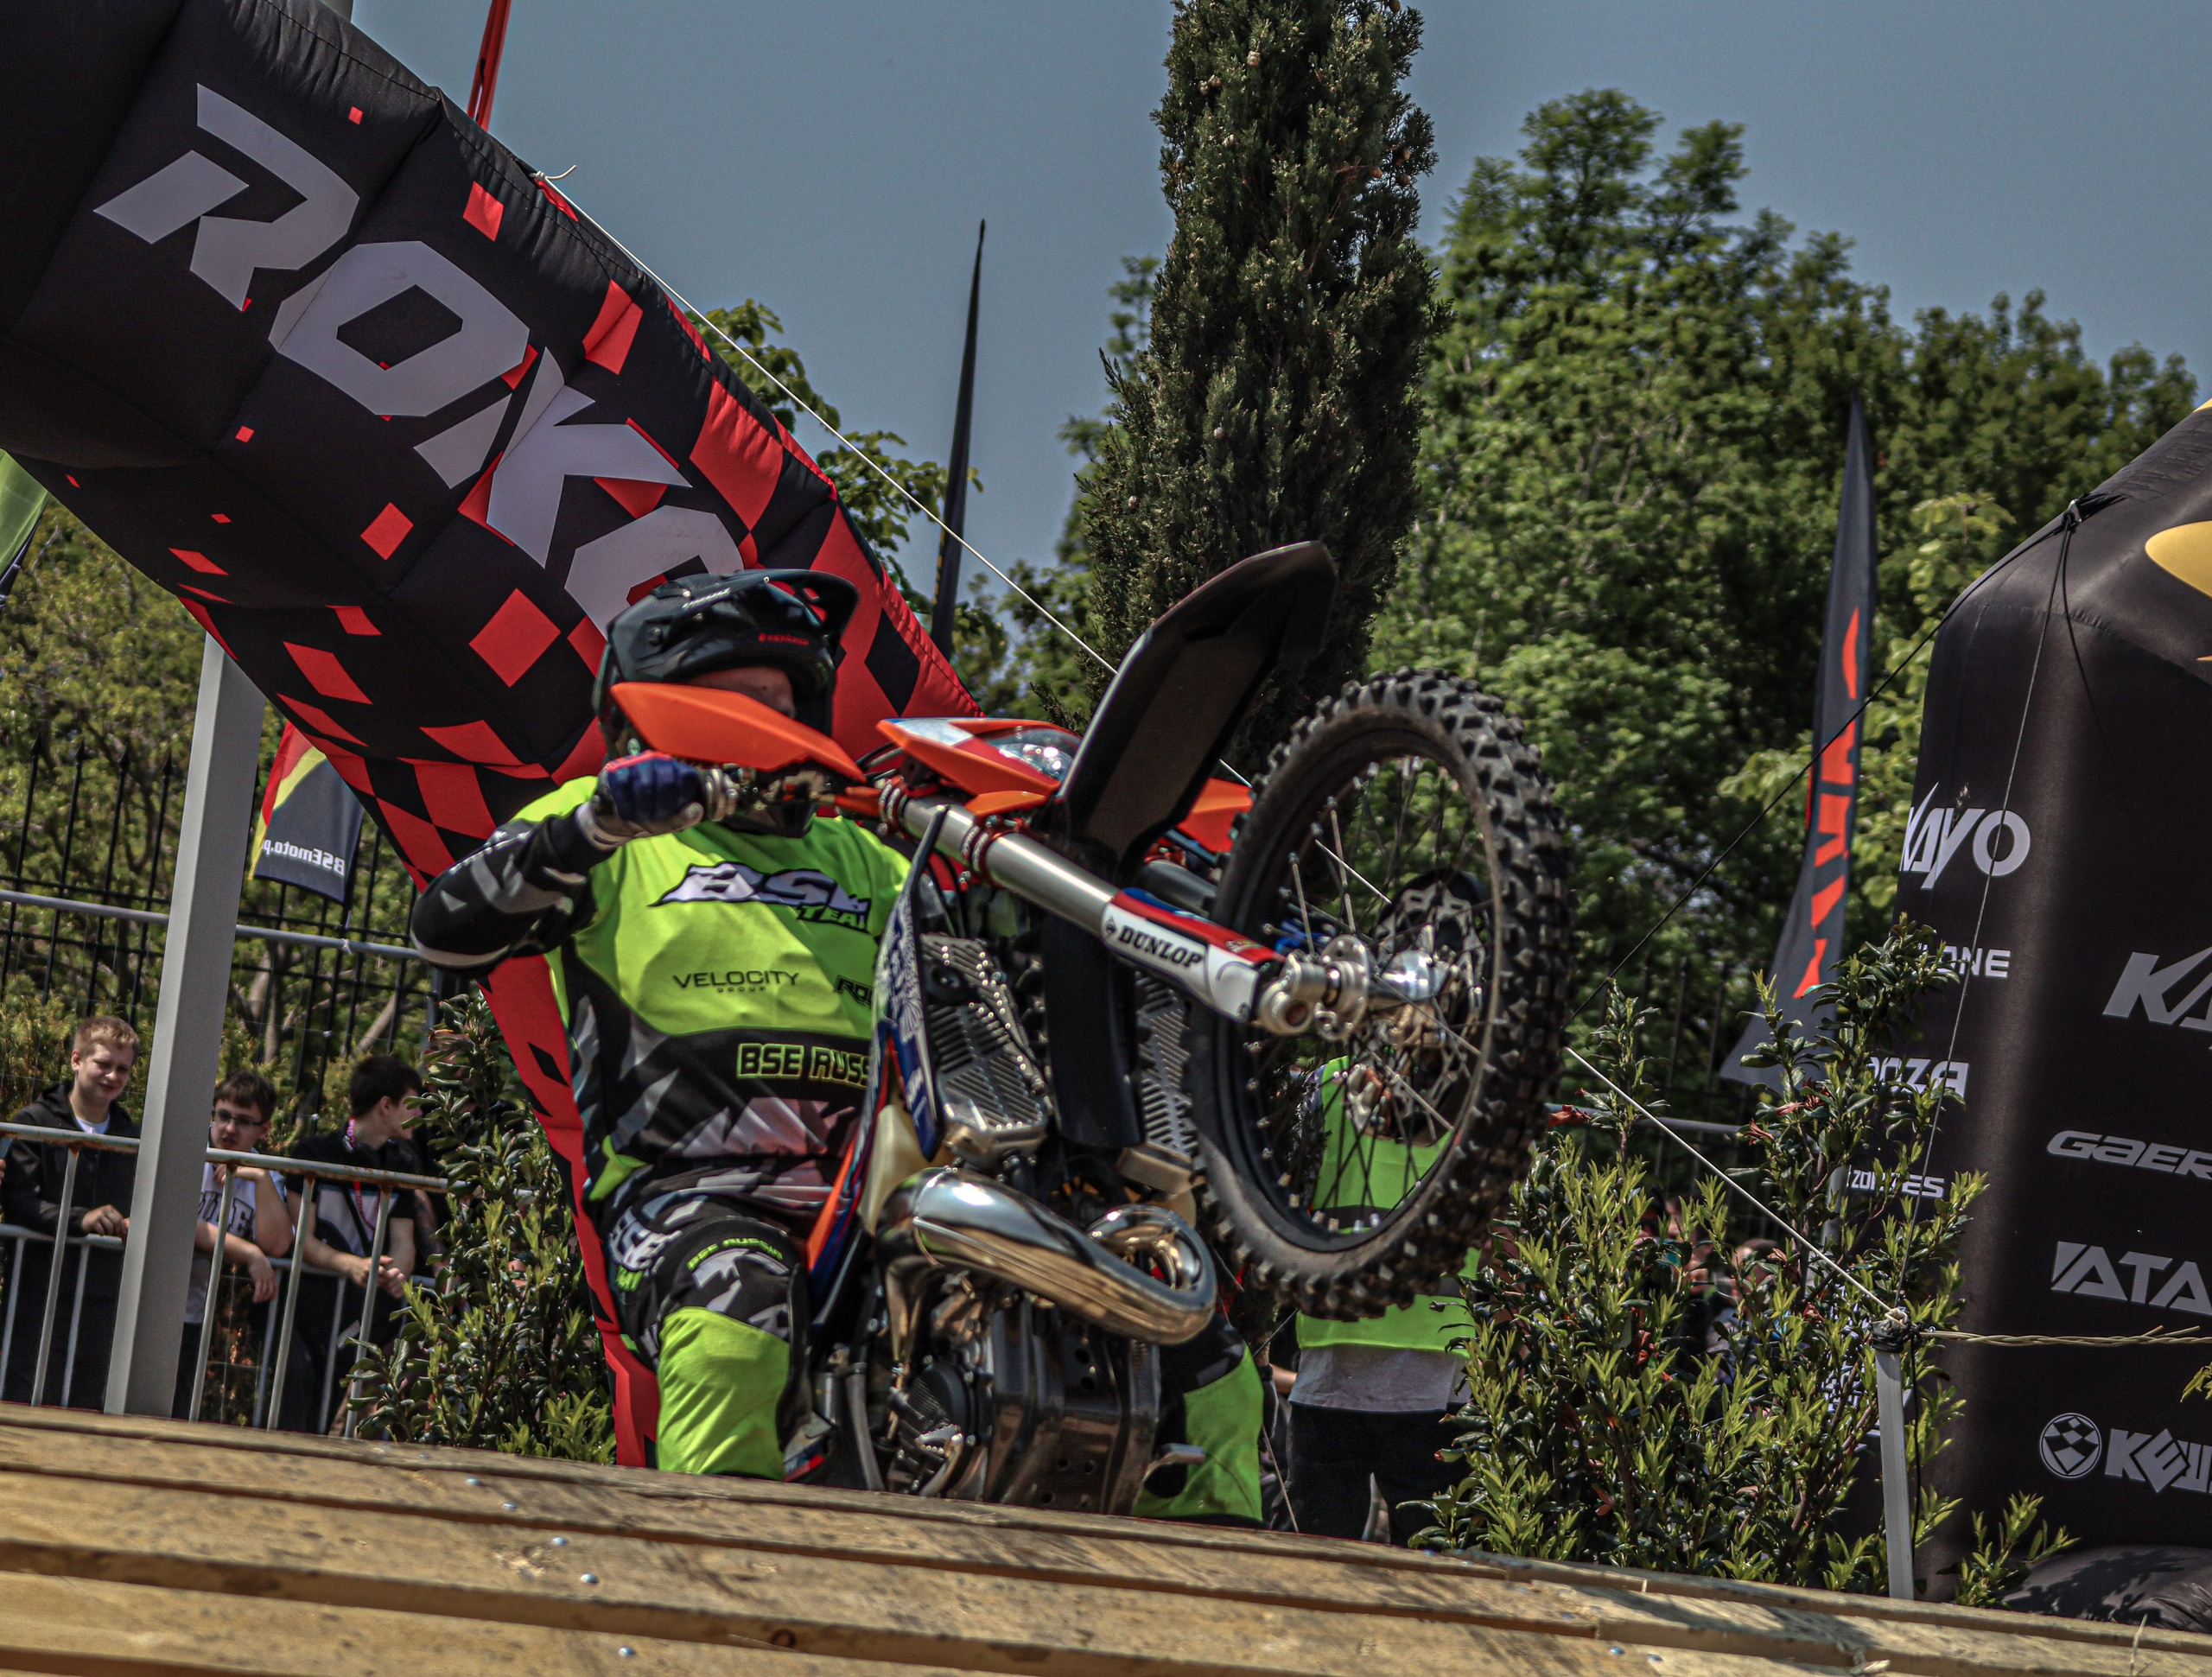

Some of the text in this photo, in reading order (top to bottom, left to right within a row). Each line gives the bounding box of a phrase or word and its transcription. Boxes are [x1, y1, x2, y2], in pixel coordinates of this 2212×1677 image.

[1118, 925, 1204, 968] DUNLOP
[672, 970, 799, 988] VELOCITY
[736, 1043, 804, 1079] BSE
